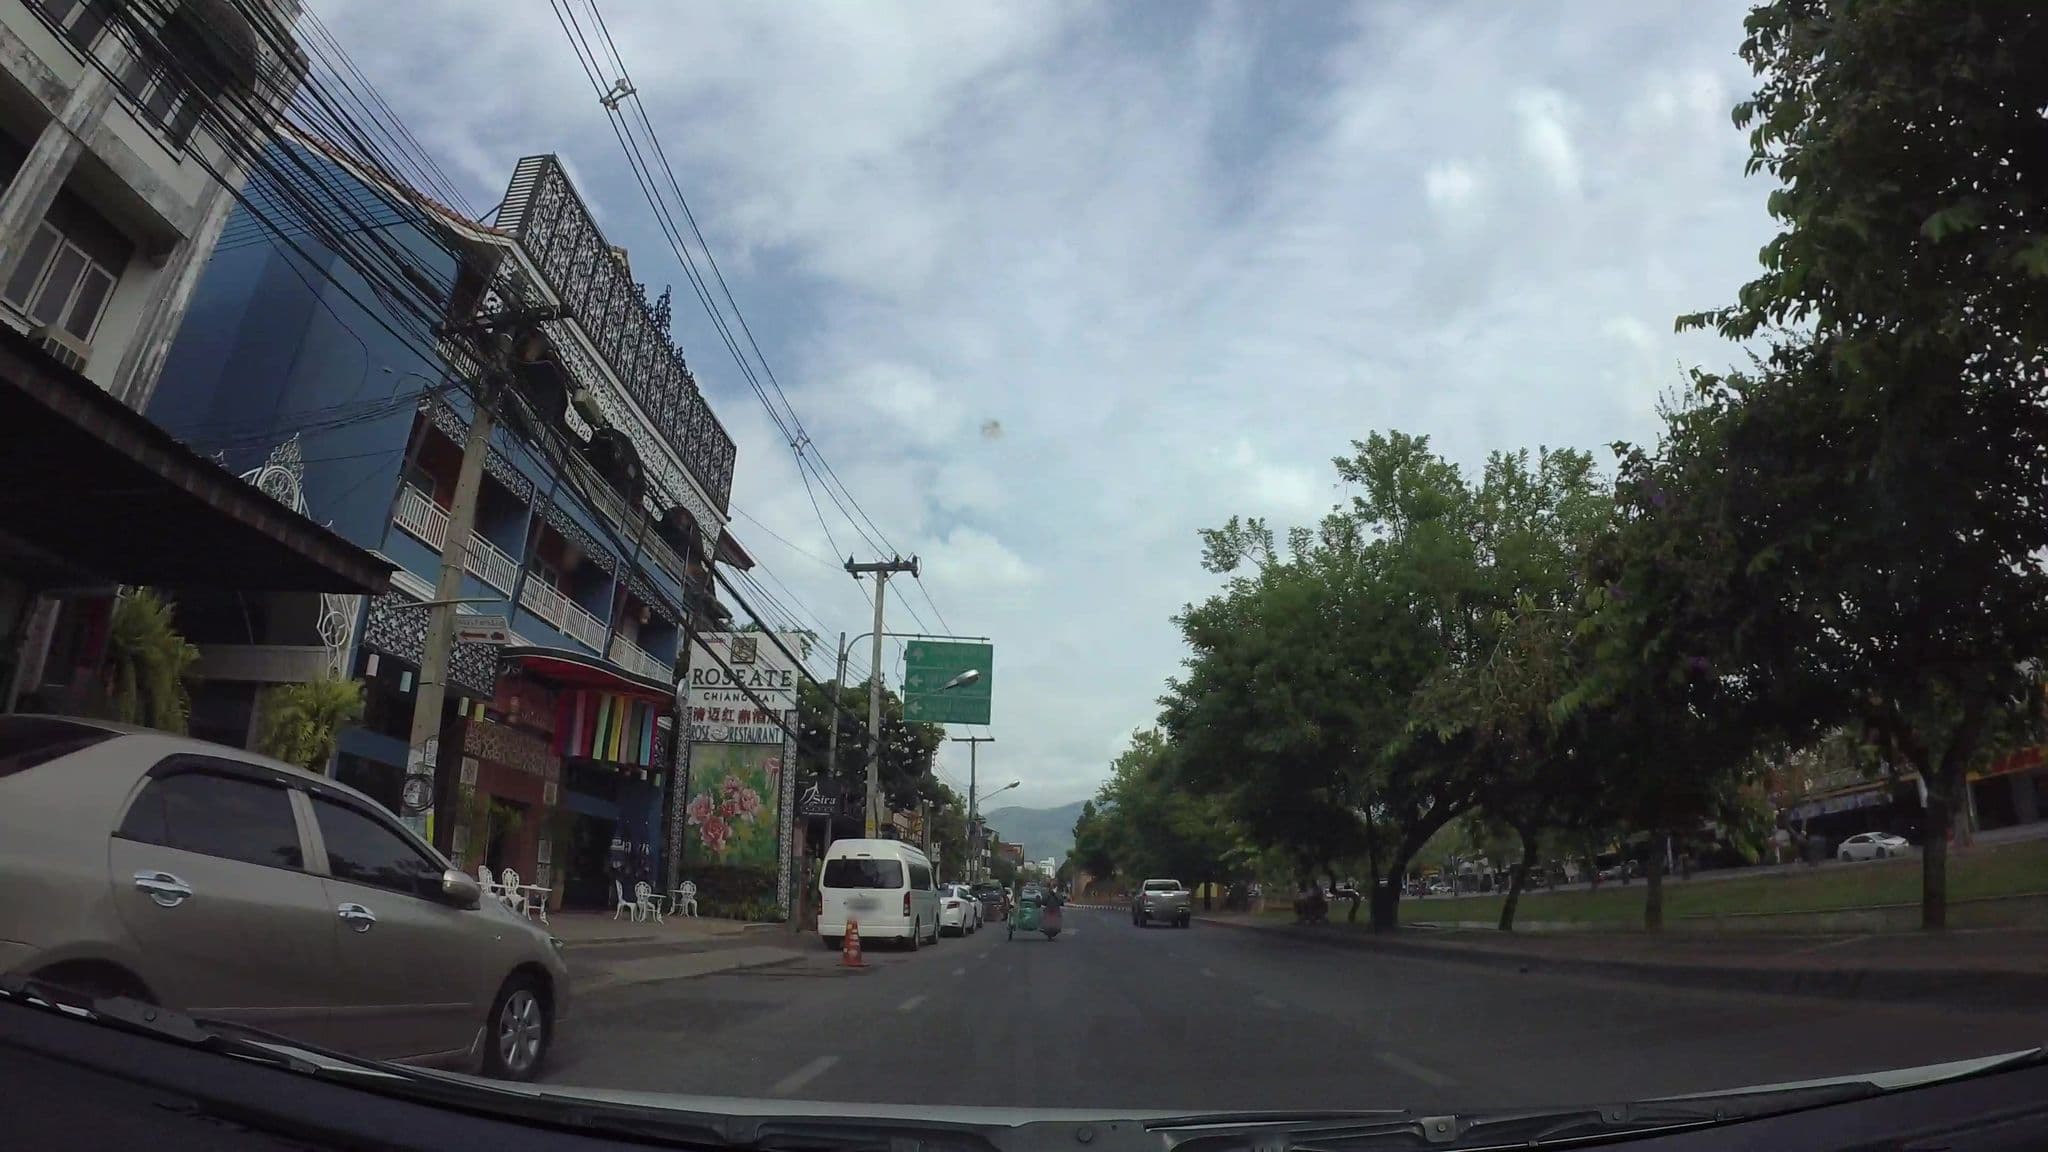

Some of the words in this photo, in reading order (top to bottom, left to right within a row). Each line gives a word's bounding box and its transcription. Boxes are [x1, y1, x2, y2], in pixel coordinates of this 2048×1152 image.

[692, 668, 793, 687] ROSEATE
[703, 692, 748, 702] CHIANG
[728, 726, 781, 743] RESTAURANT
